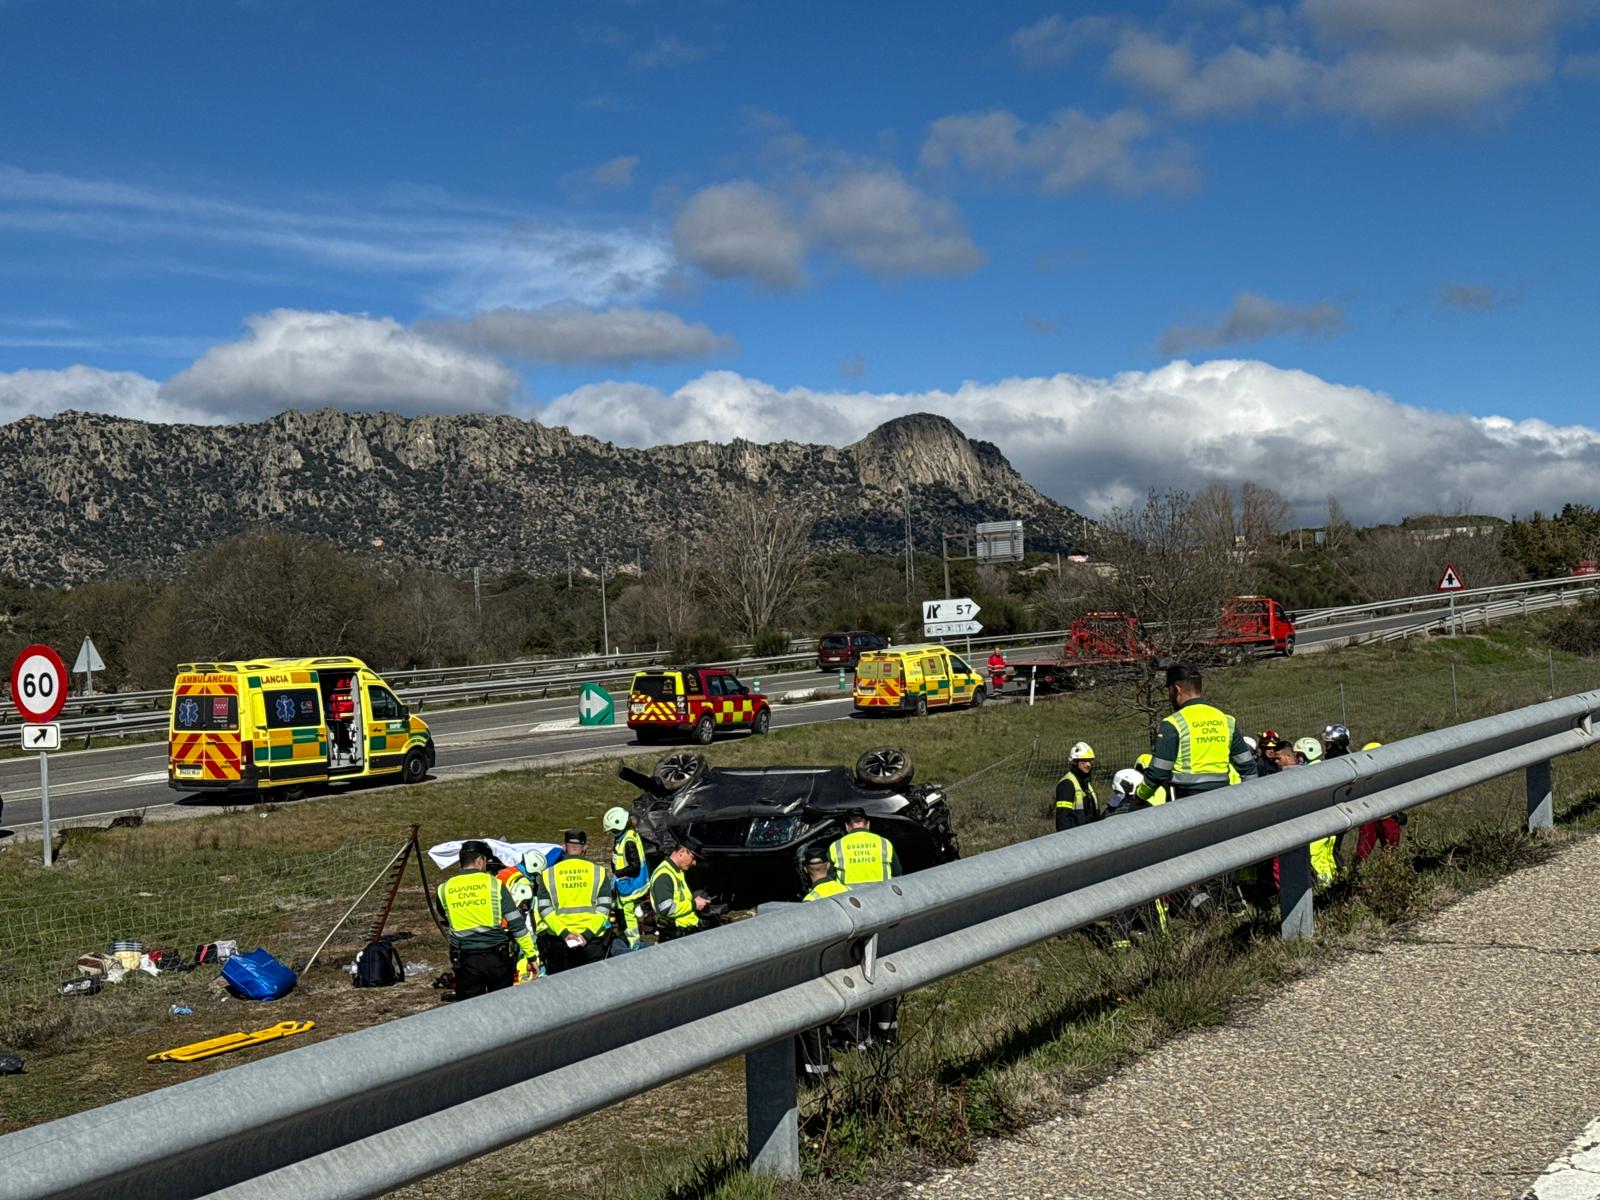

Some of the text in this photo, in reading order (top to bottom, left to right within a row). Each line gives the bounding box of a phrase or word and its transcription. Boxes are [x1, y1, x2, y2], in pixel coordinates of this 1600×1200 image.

[956, 604, 972, 615] 57
[181, 675, 232, 683] AMBULANCIA
[23, 672, 53, 698] 60
[1196, 735, 1226, 744] TRAFICO
[847, 842, 876, 850] GUARDIA
[849, 856, 876, 864] TRAFICO
[448, 883, 487, 894] GUARDIA
[451, 898, 487, 909] TRAFICO
